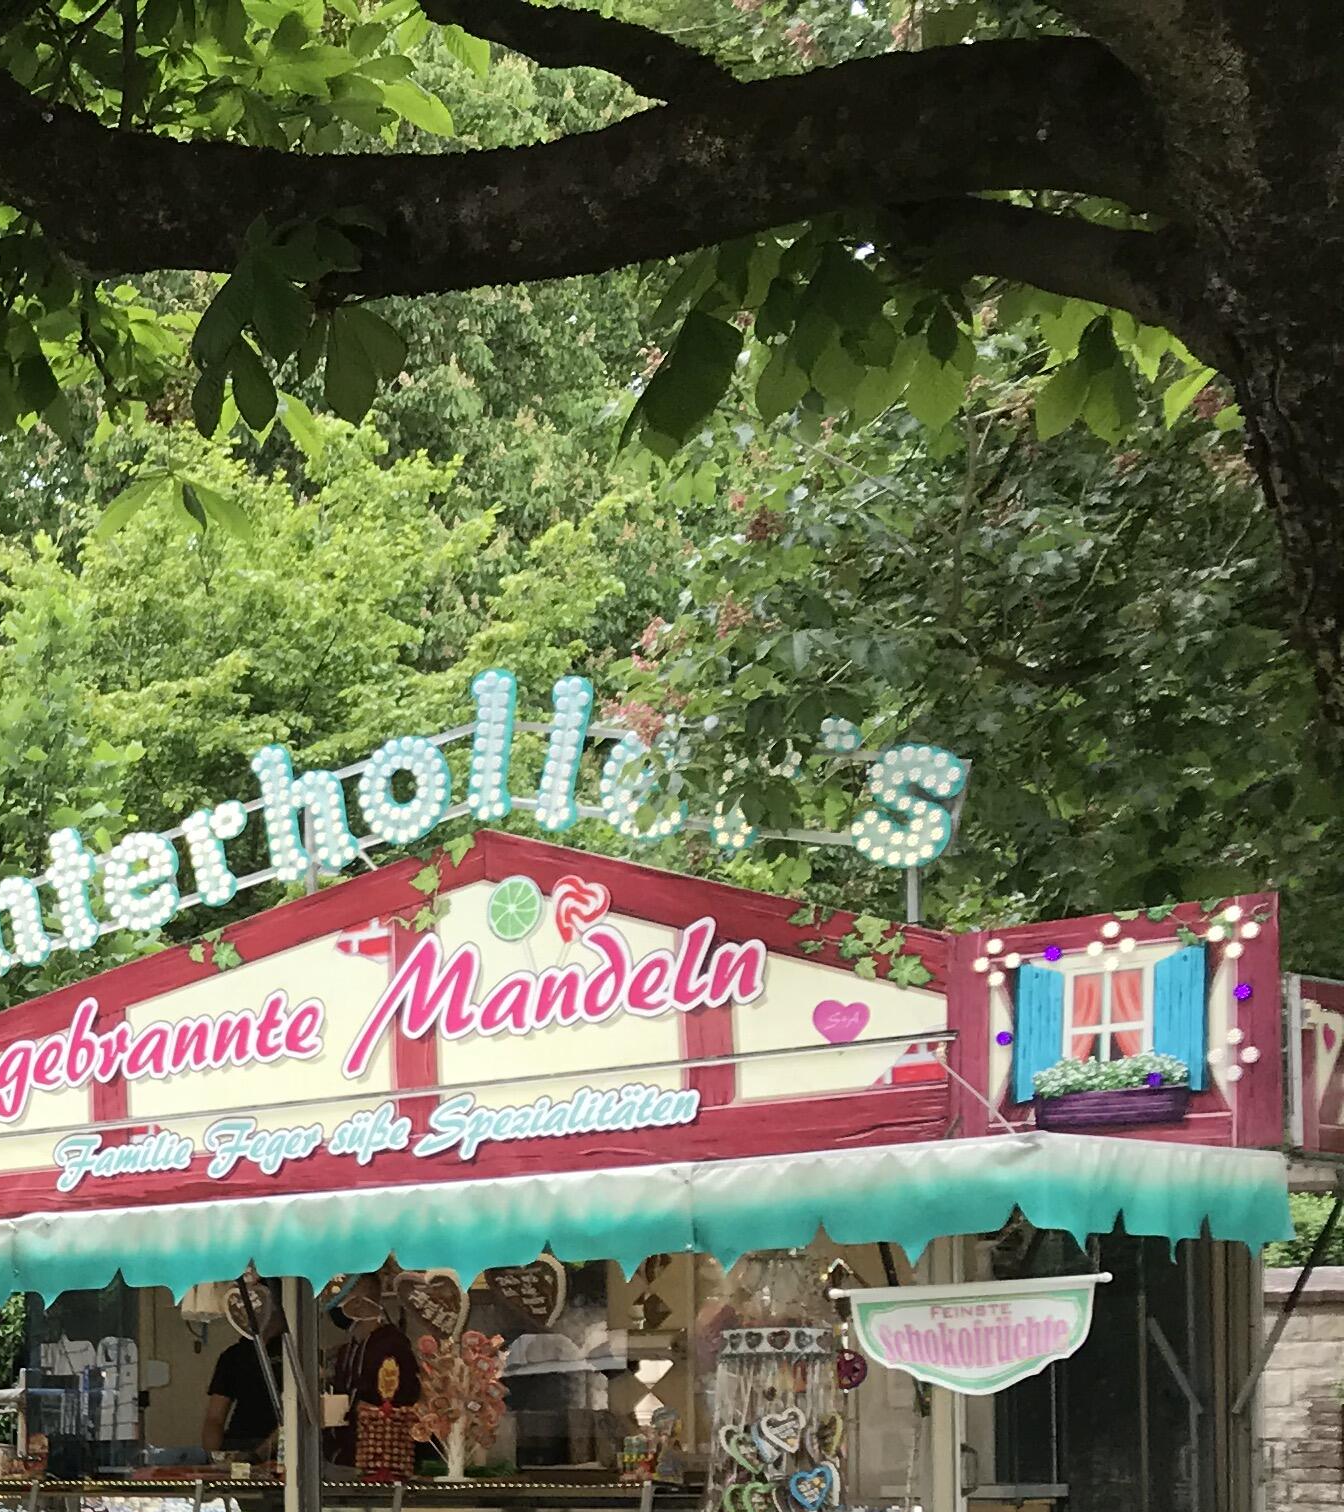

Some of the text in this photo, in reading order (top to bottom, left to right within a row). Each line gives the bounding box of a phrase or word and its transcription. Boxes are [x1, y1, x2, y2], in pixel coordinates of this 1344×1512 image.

[344, 919, 766, 1077] Mandeln
[56, 1084, 700, 1191] Familie Feger süße Spezialitäten
[879, 1314, 1070, 1369] Schokofrüchte
[931, 1303, 1012, 1319] FEINSTE
